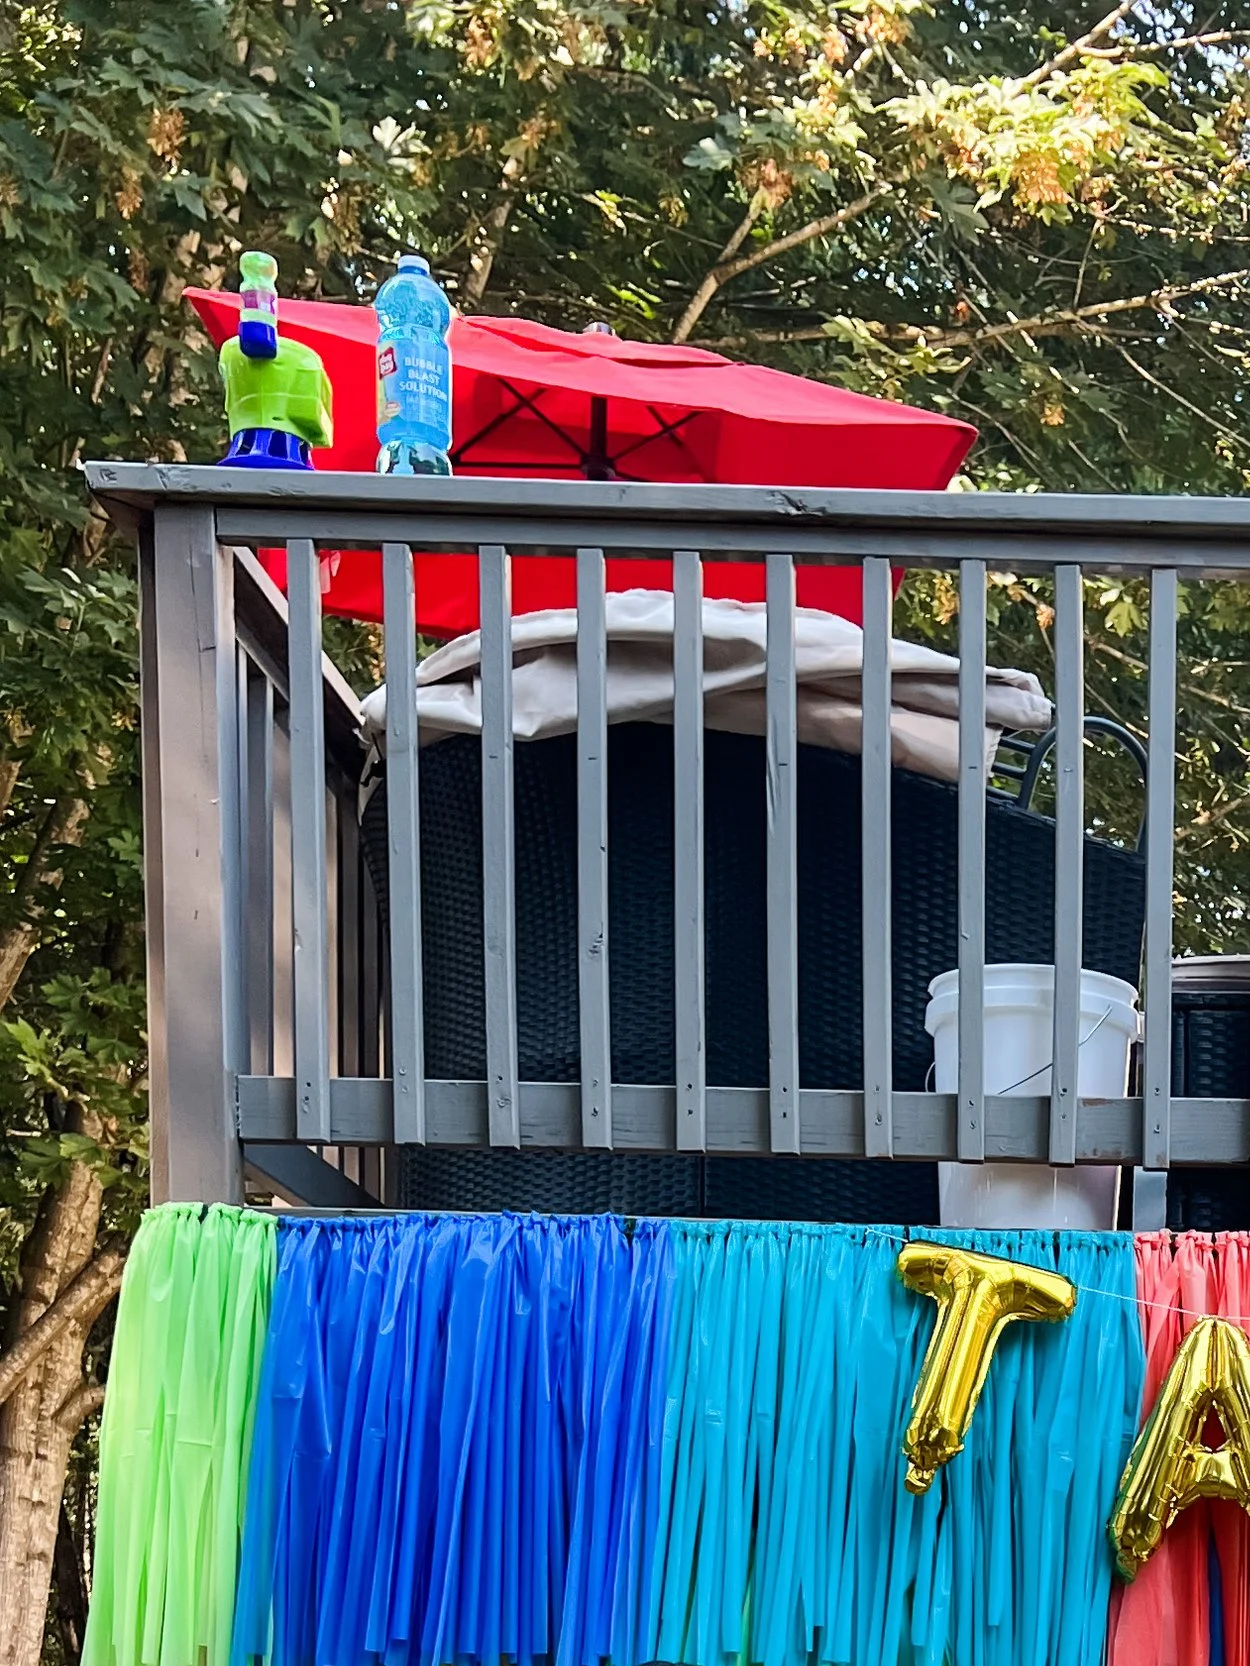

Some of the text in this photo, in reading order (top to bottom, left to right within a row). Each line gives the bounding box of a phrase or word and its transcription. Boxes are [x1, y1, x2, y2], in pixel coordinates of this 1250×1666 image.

[404, 356, 443, 375] BUBBLE
[408, 369, 440, 386] BLAST
[399, 380, 448, 402] SOLUTION
